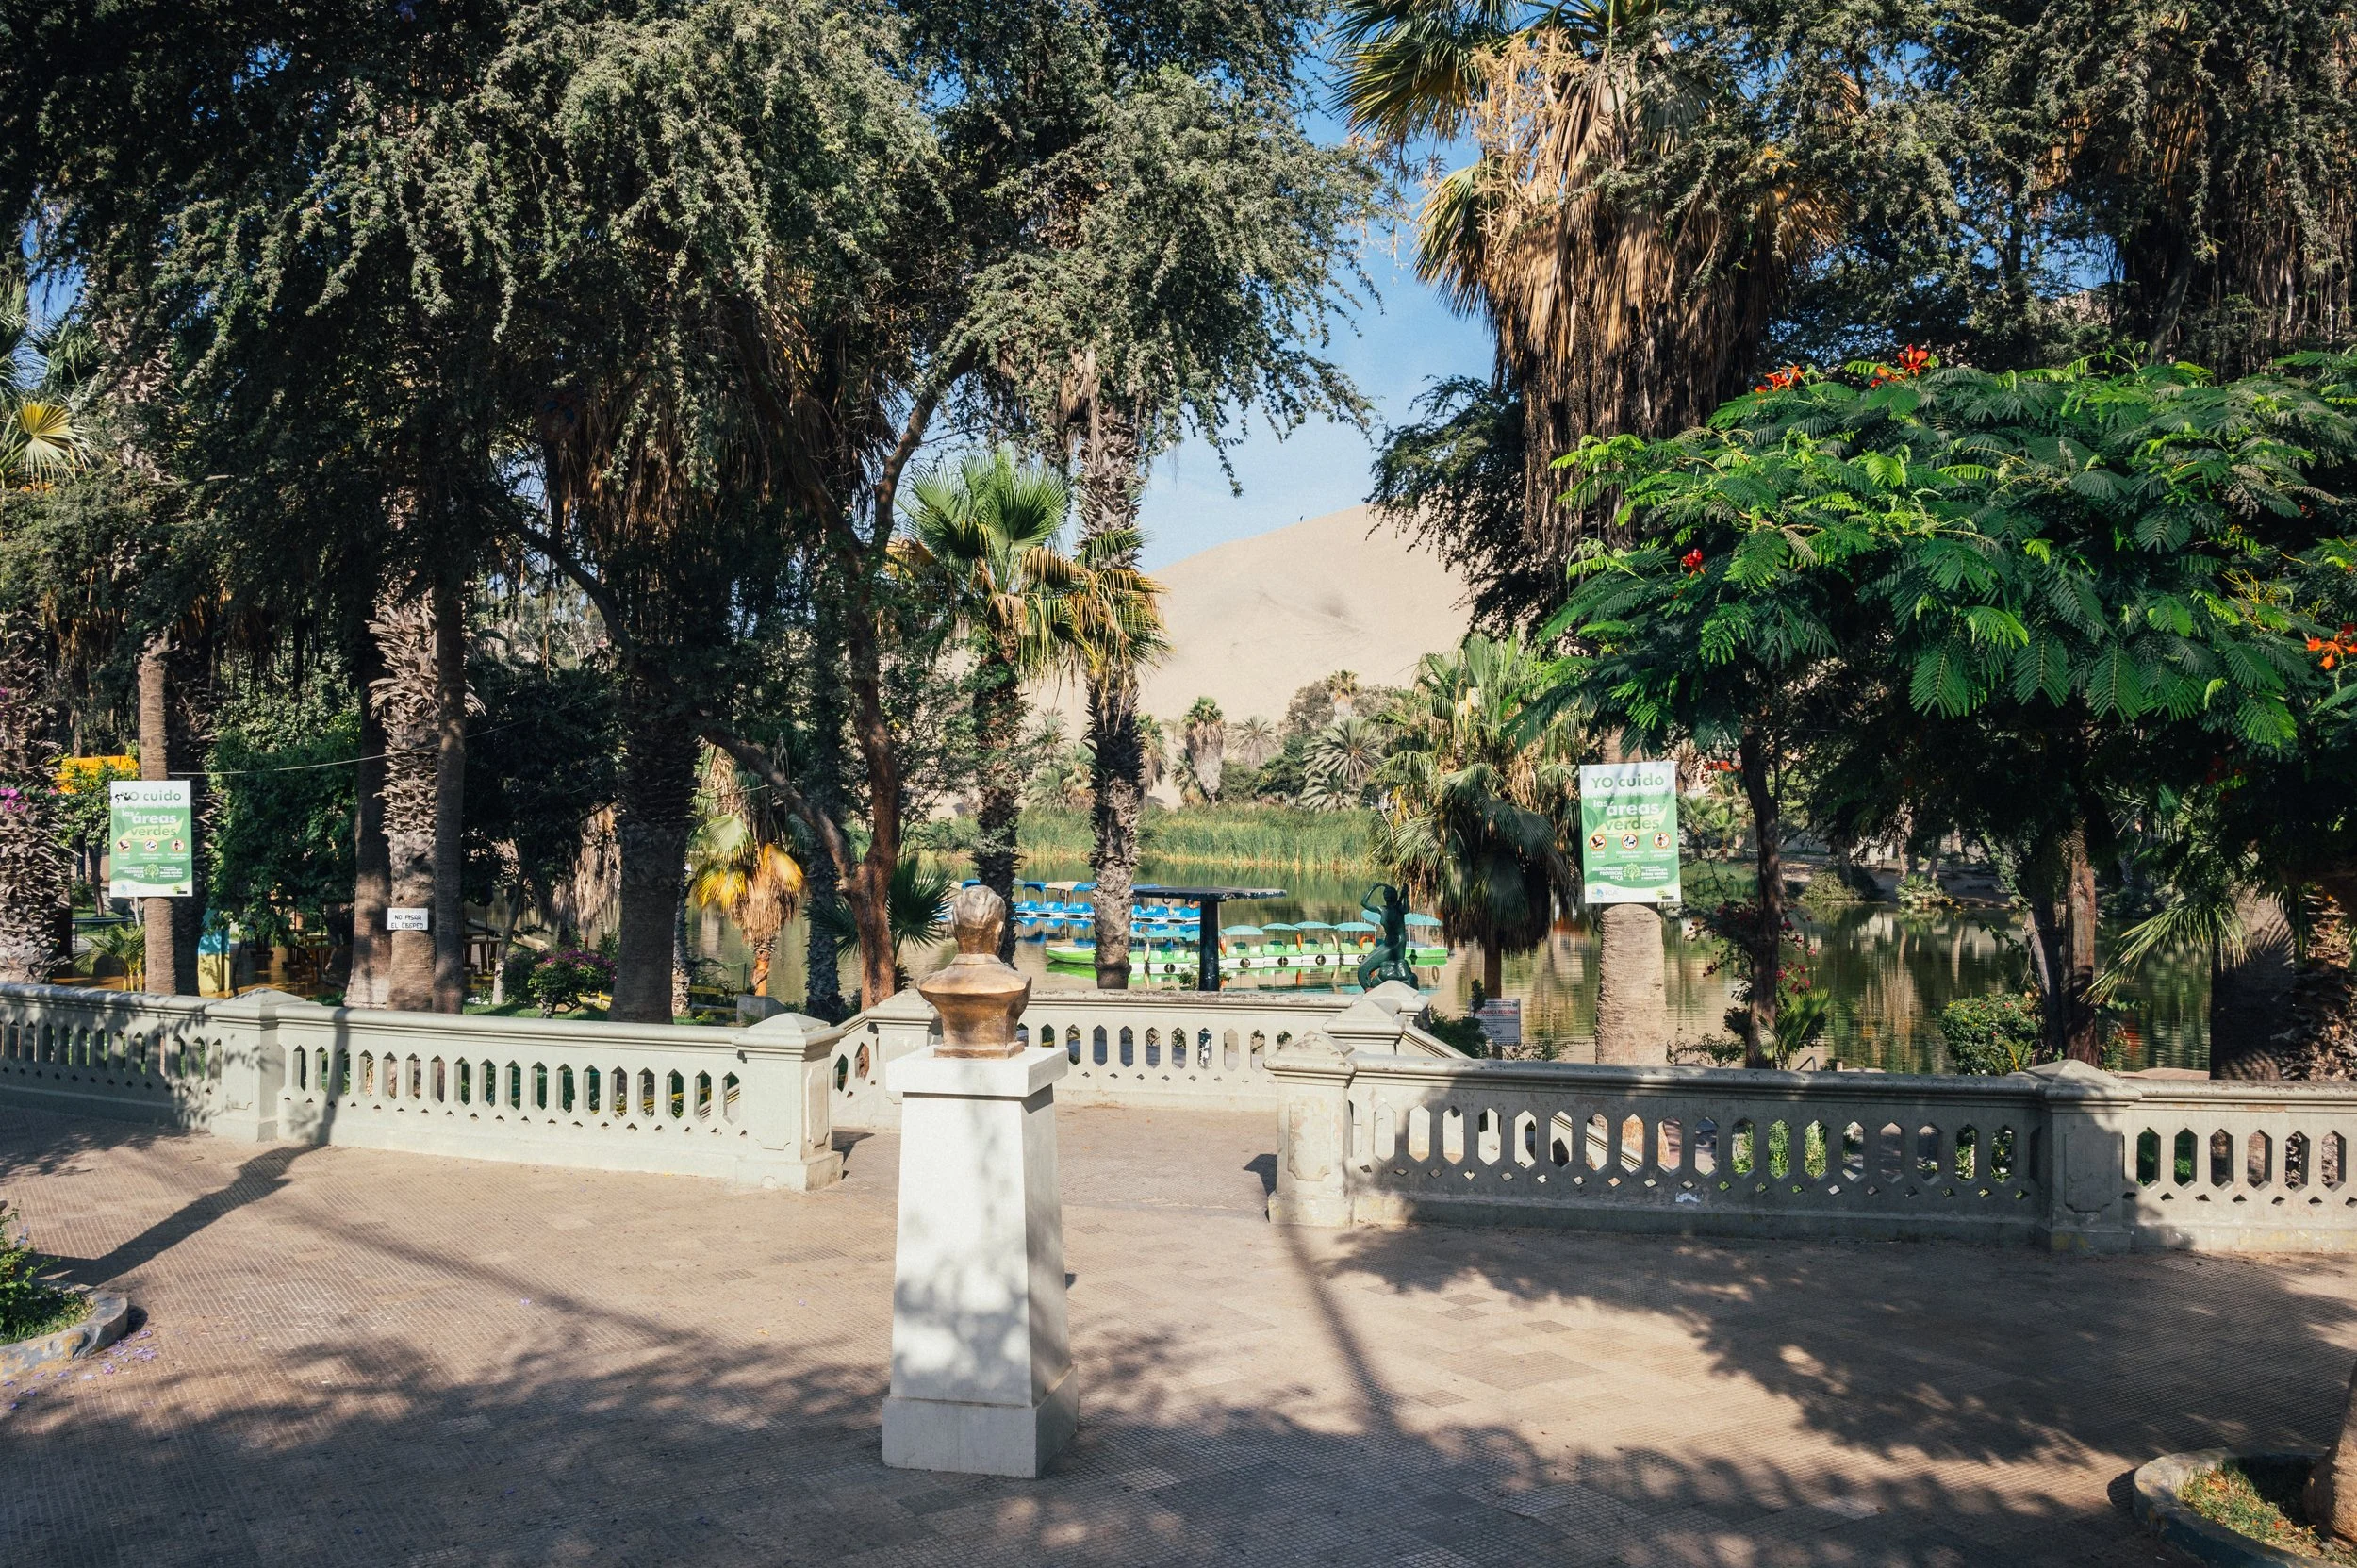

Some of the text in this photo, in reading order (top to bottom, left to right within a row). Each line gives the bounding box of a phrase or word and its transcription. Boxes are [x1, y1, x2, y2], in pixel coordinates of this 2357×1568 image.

[1591, 773, 1664, 789] YO cuido
[143, 790, 181, 801] cuido
[1592, 800, 1659, 817] las áreas
[132, 812, 177, 824] áreas
[1605, 816, 1660, 831] verdes
[132, 825, 177, 836] verdes
